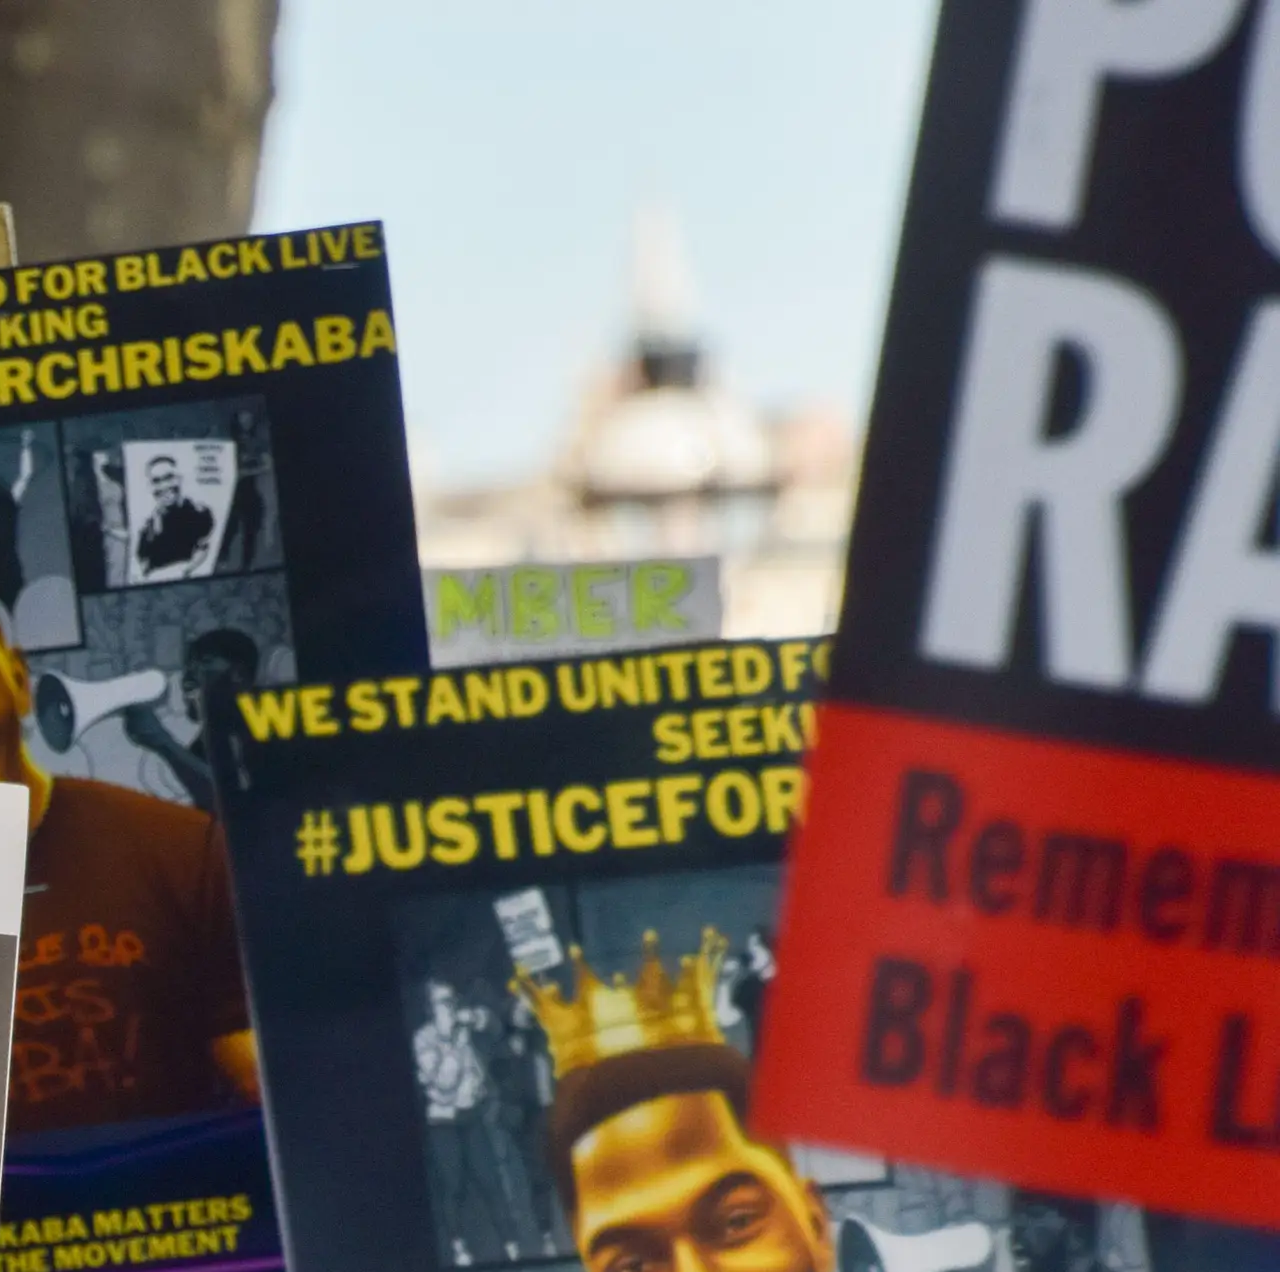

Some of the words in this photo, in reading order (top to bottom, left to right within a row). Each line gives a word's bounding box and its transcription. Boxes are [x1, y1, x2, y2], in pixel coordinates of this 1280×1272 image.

[16, 258, 108, 305] FOR
[115, 241, 274, 292] BLACK
[281, 224, 383, 269] LIVE
[237, 684, 340, 743] WE
[347, 663, 550, 733] STAND
[555, 644, 774, 714] UNITED
[862, 954, 1168, 1137] Black
[54, 1225, 240, 1270] MOVEMENT
[93, 1193, 252, 1236] MATTERS
